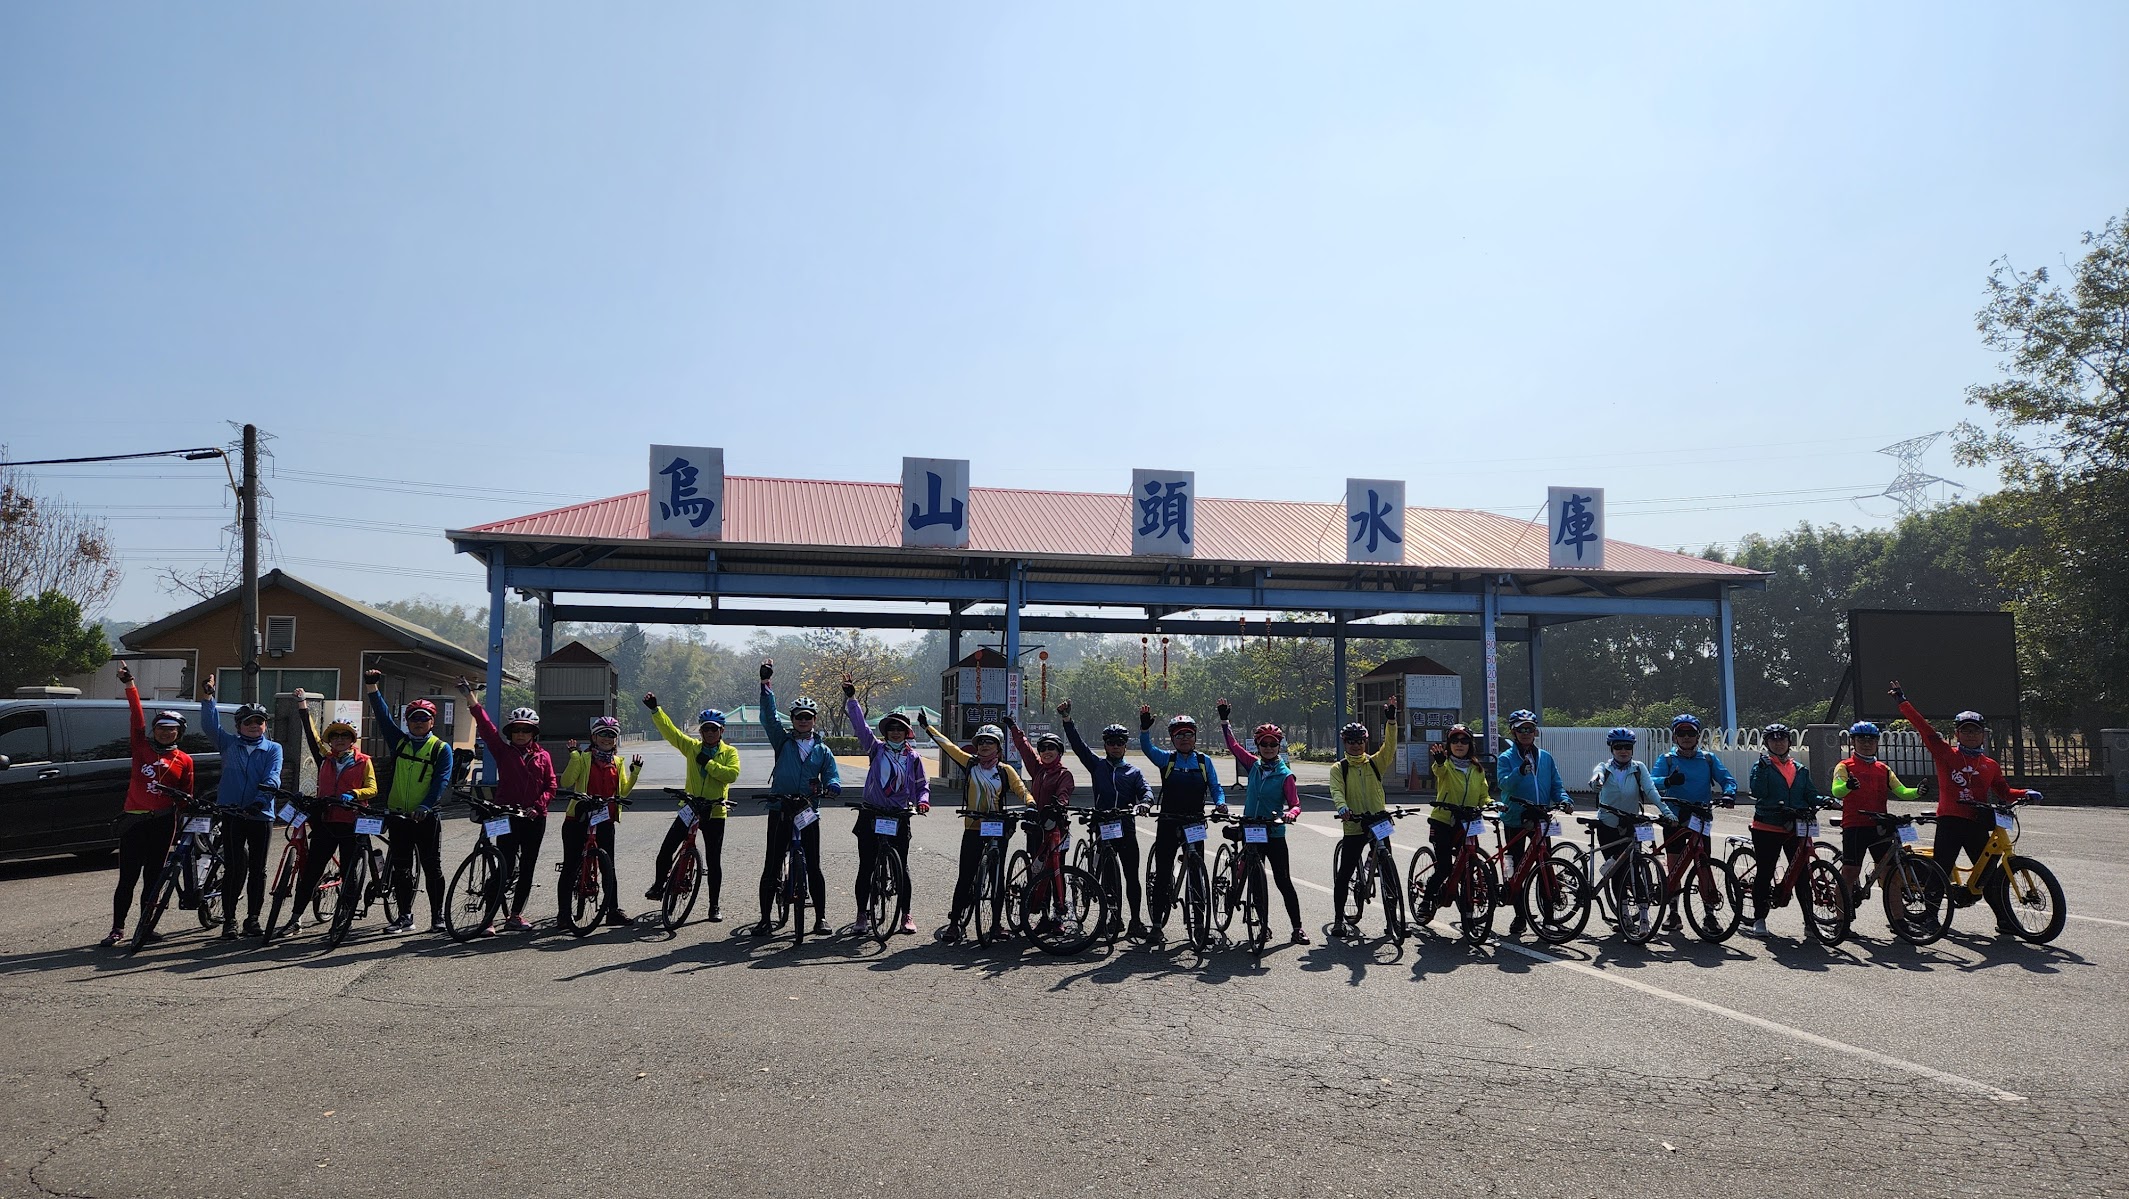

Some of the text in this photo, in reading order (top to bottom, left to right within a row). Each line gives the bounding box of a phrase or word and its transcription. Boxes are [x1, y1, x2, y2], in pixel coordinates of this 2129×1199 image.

[659, 457, 1598, 561] 烏 山 頭 水 庫
[966, 707, 1008, 723] 售票
[1413, 712, 1455, 727] 售票處
